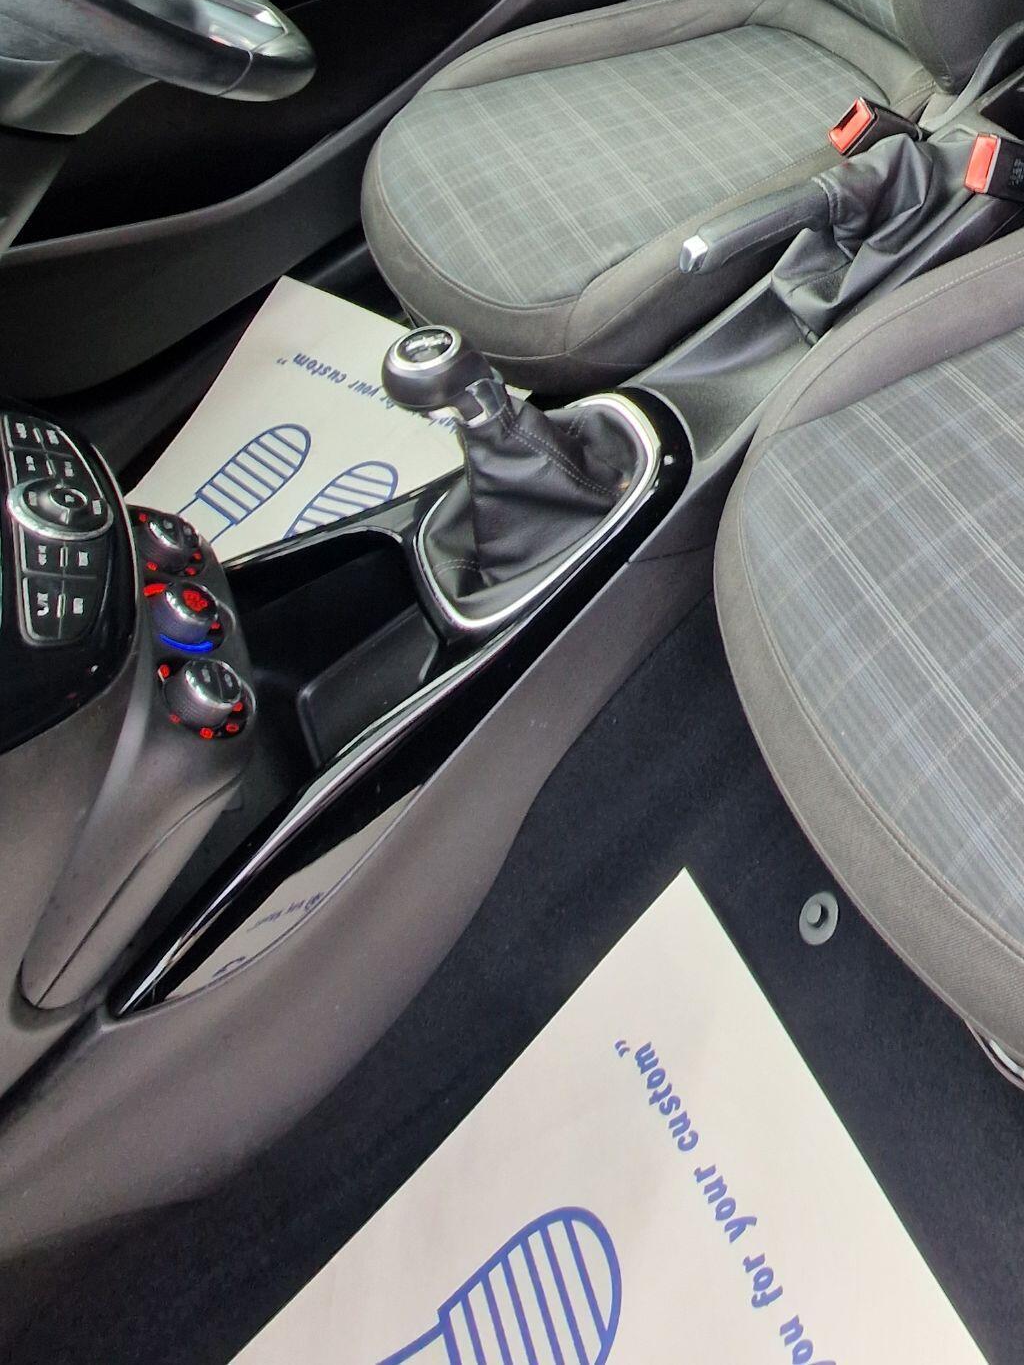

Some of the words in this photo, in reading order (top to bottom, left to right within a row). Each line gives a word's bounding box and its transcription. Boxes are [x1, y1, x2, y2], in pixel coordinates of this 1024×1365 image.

[693, 1163, 758, 1244] your
[741, 1253, 784, 1310] for
[780, 1314, 837, 1365] ou
